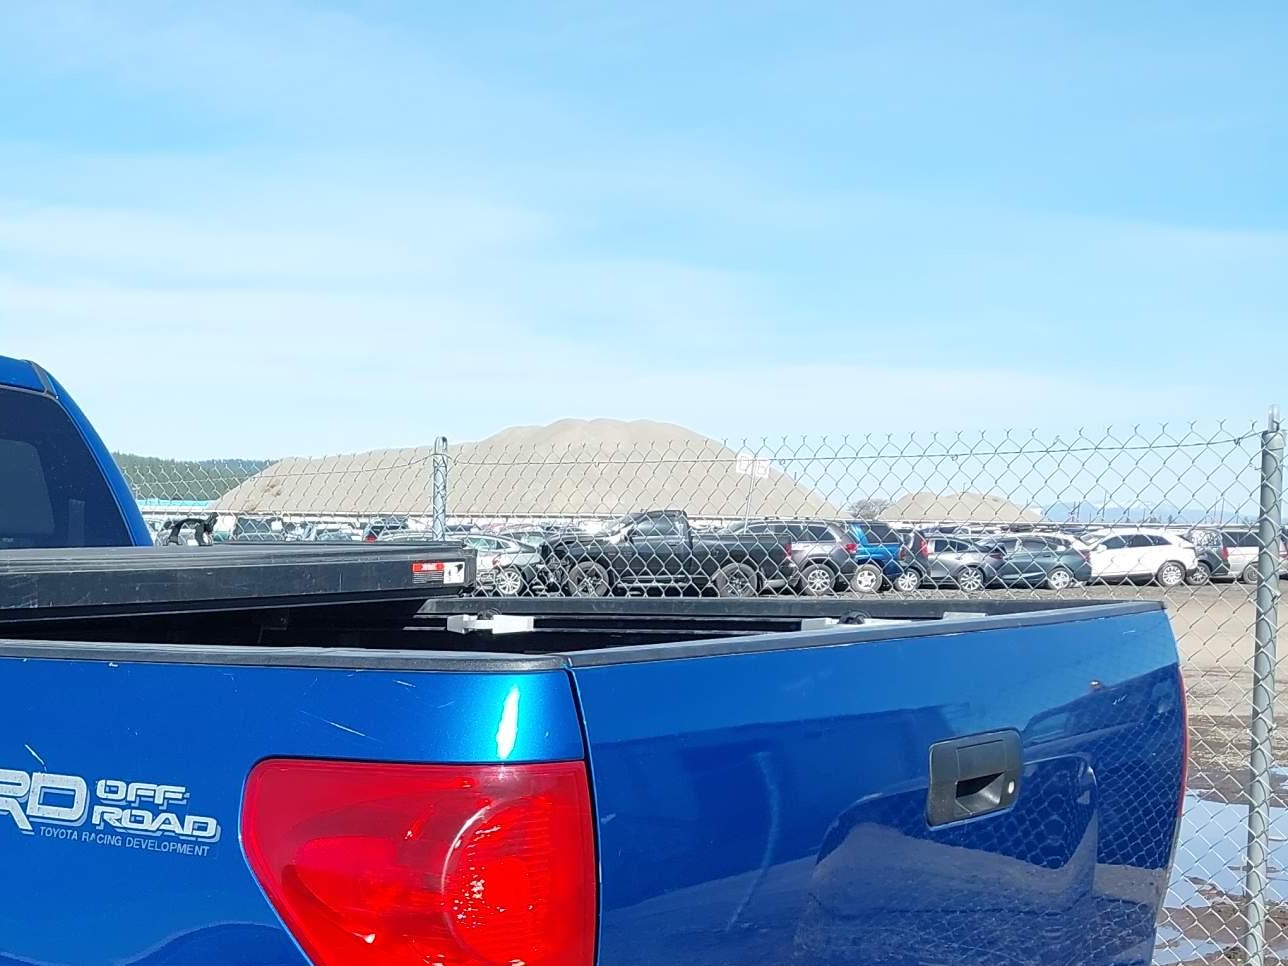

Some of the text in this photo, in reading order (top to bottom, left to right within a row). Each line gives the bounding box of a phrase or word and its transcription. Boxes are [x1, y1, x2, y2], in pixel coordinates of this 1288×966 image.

[96, 779, 189, 808] OFF
[92, 805, 221, 843] ROAD
[39, 826, 211, 857] TOYOTA RACING DEVELOPMENT
